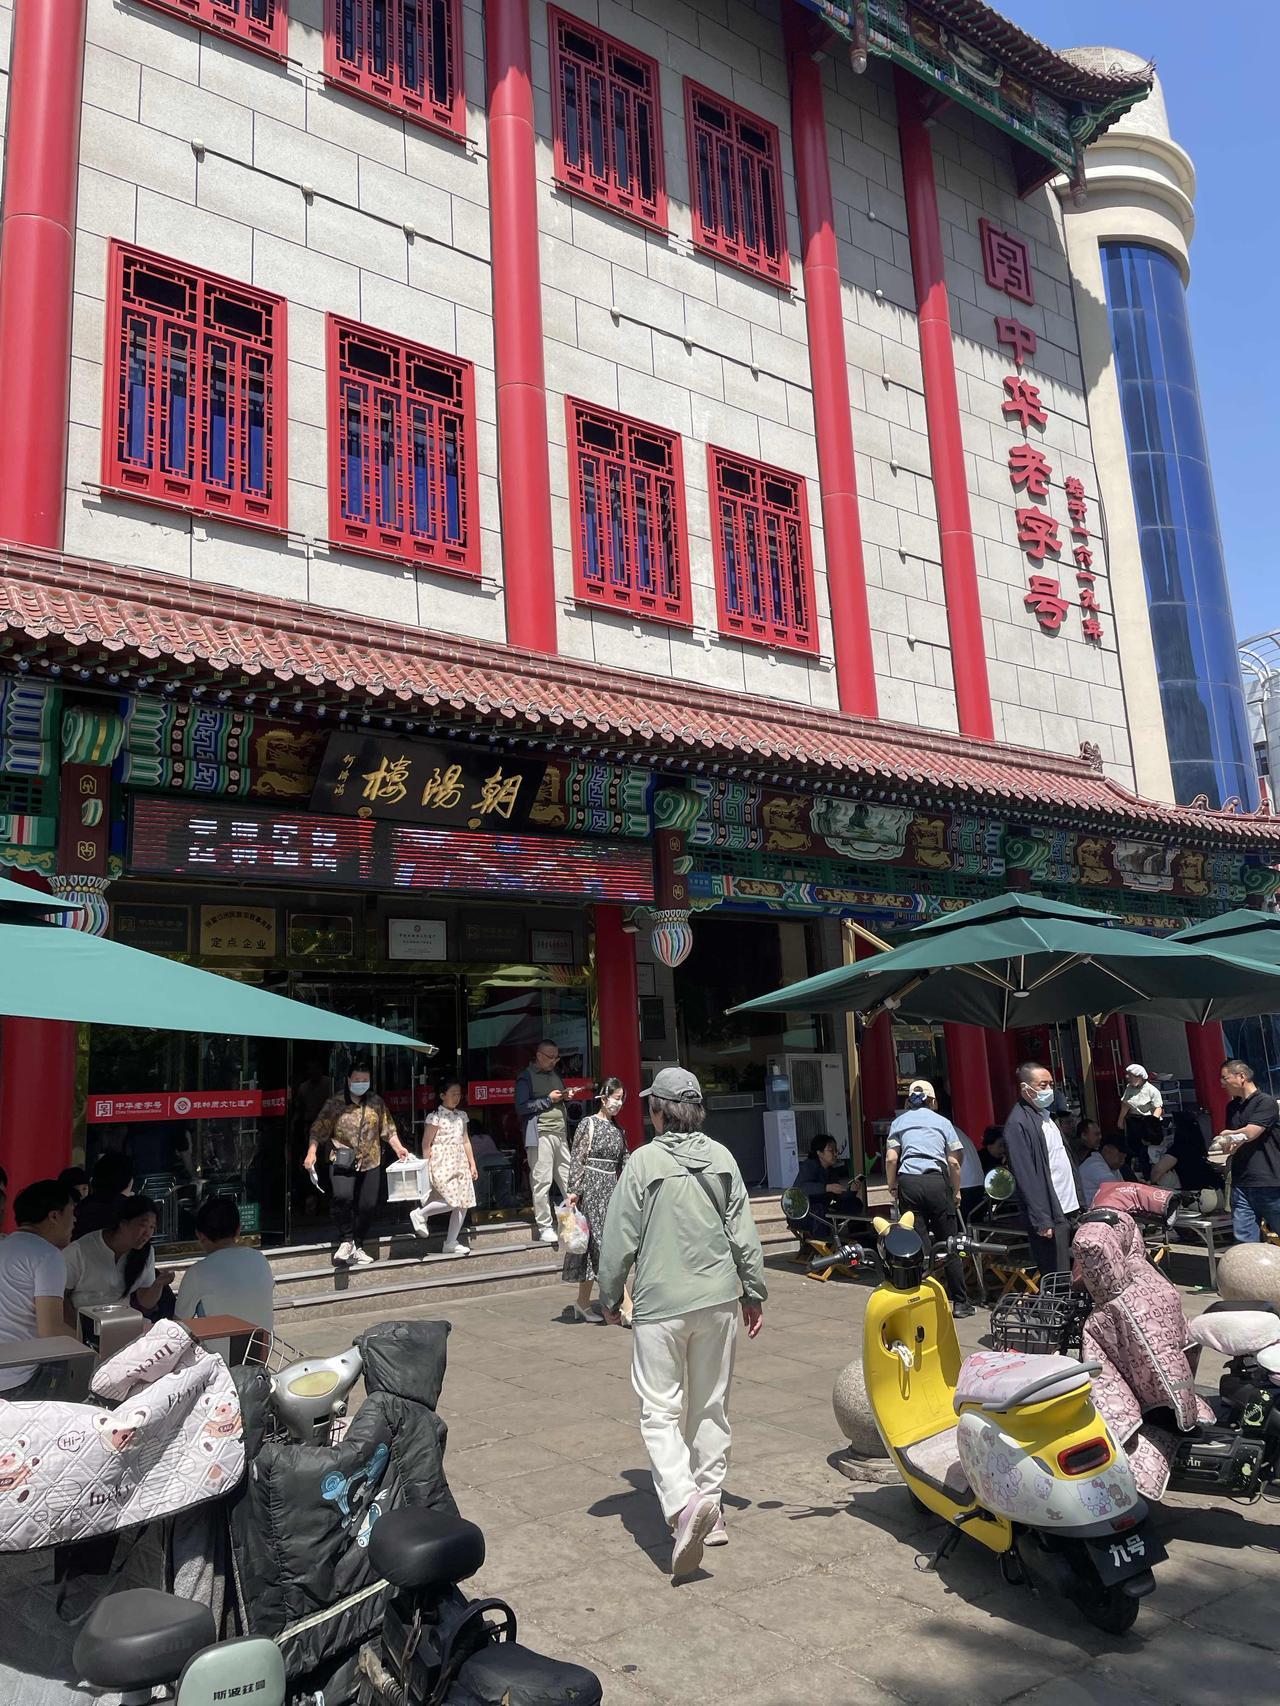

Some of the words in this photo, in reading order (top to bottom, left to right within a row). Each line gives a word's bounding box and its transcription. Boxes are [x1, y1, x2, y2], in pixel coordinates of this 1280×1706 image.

[994, 314, 1069, 630] 中华老字号
[1063, 475, 1104, 641] 始于一六一九年
[210, 937, 267, 950] 定点企业
[115, 1101, 162, 1110] 中华老字号
[193, 1100, 254, 1109] 非物质文化遗产
[126, 1344, 174, 1377] lucky
[1109, 1534, 1145, 1567] 九号
